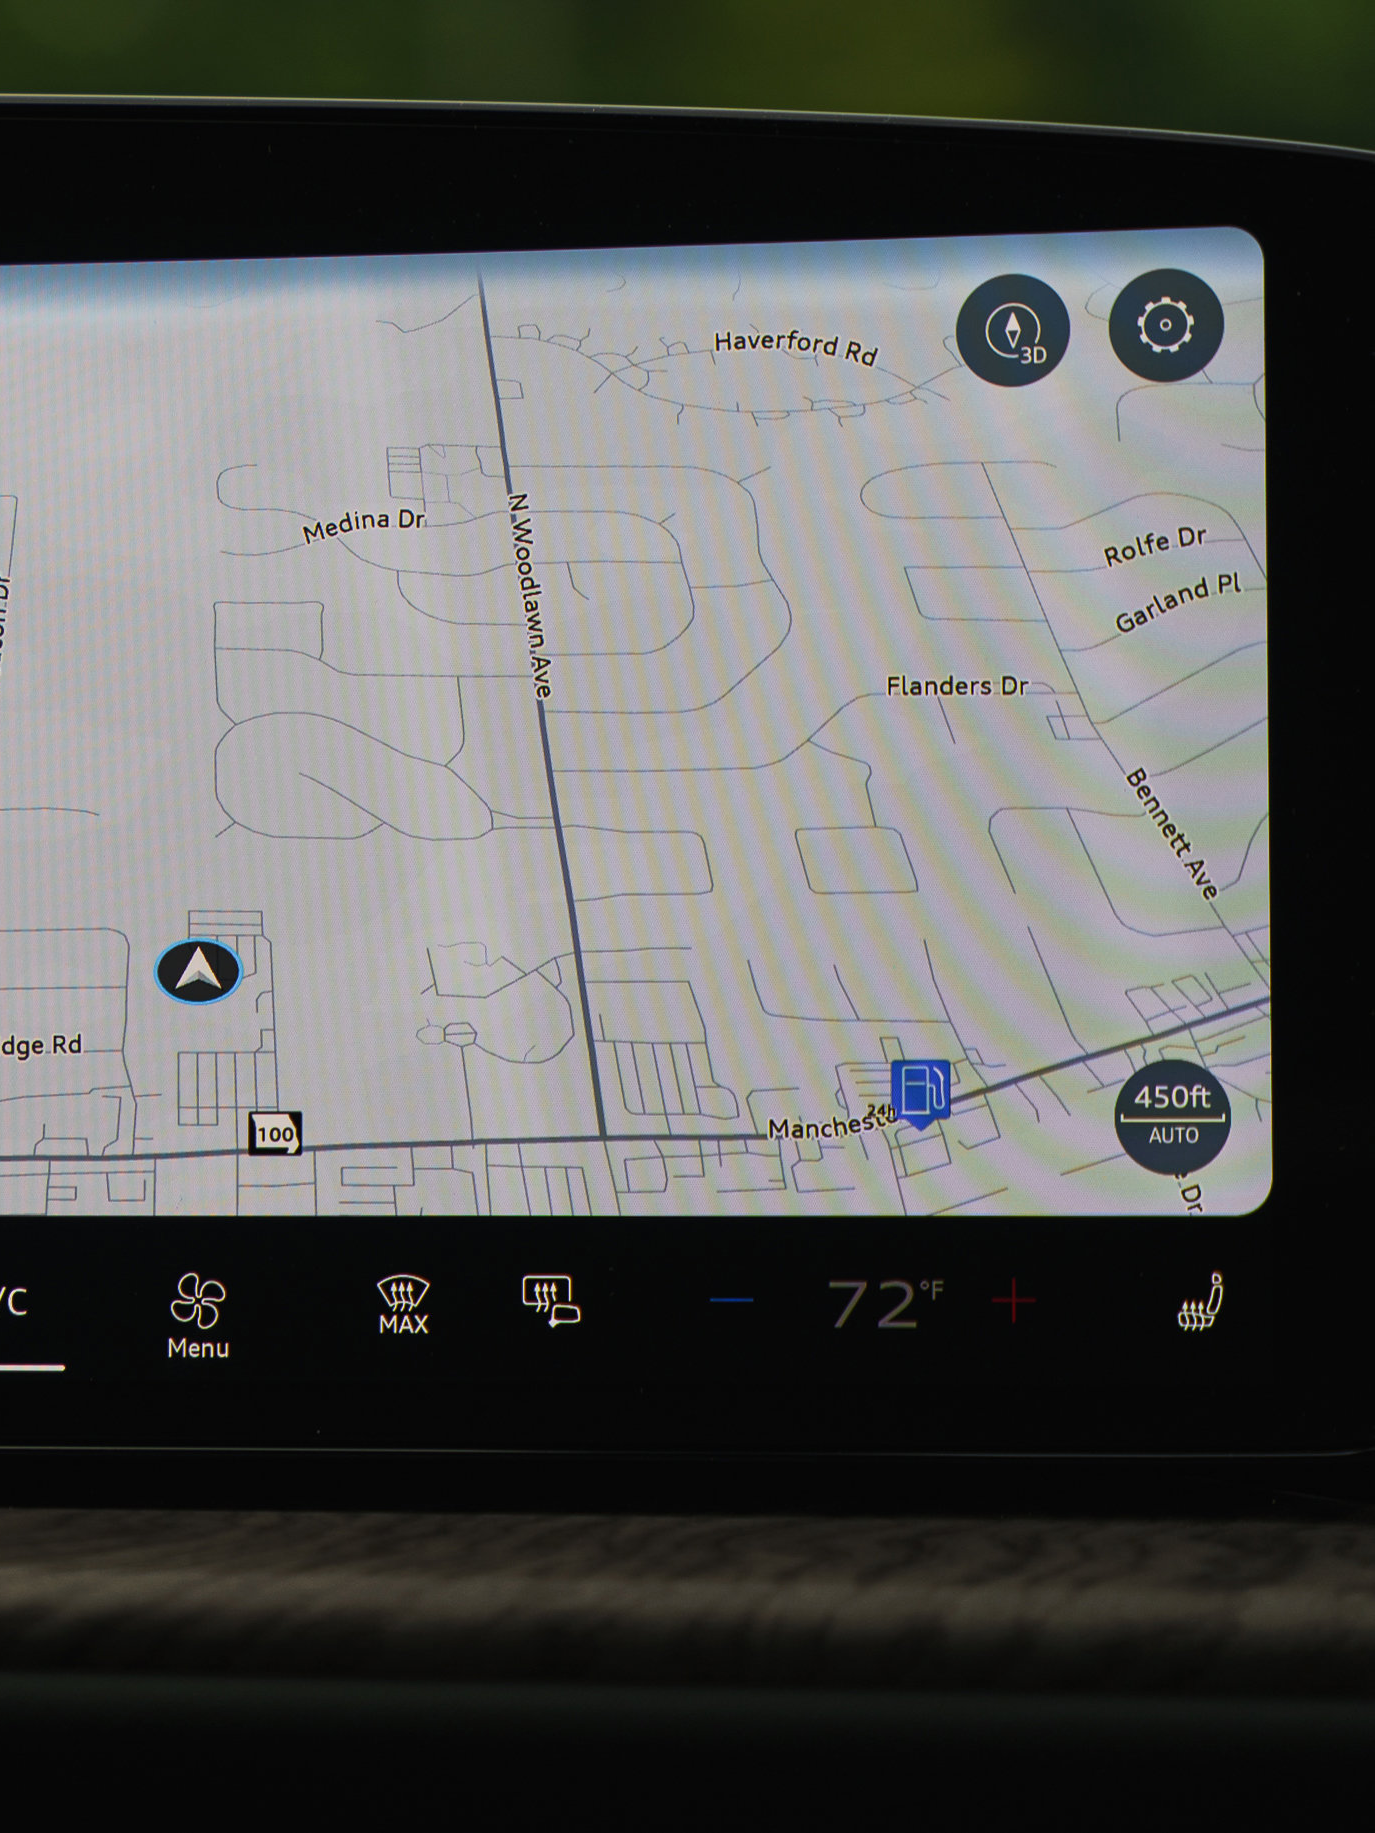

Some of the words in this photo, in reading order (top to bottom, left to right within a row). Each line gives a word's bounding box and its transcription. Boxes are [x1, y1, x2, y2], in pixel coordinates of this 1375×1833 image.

[715, 330, 838, 356] Haverford
[845, 341, 878, 367] Rd
[1020, 346, 1047, 364] 3D
[509, 493, 529, 512] N
[303, 511, 389, 544] Medina
[399, 509, 425, 528] Dr
[1104, 532, 1169, 568] Rolfe
[1178, 527, 1206, 547] Dr
[513, 518, 544, 648] Woodlawn
[1116, 576, 1209, 633] Garland
[1218, 571, 1241, 594] Pl
[532, 655, 551, 698] Ave
[887, 677, 991, 696] Flanders
[1001, 677, 1029, 696] Dr
[1126, 767, 1191, 858] Bennett
[1184, 859, 1217, 900] Ave
[53, 1034, 82, 1053] Rd
[1134, 1084, 1211, 1109] 450ft
[867, 1104, 896, 1117] 24h
[258, 1127, 293, 1143] 100
[1149, 1127, 1200, 1144] AUTO
[1181, 1184, 1203, 1212] Dr
[380, 1315, 429, 1335] MAX
[168, 1338, 229, 1358] Menu
